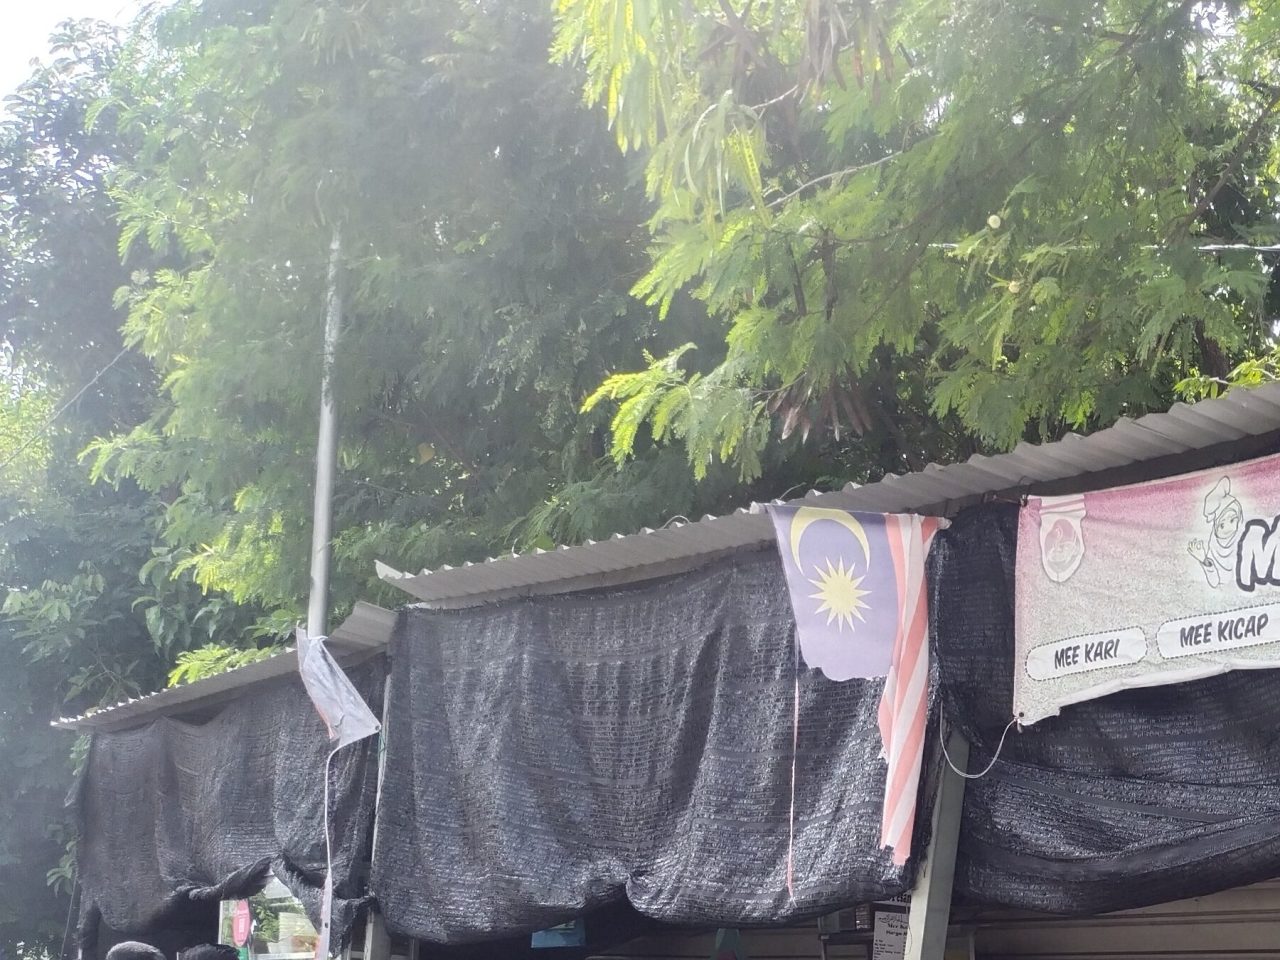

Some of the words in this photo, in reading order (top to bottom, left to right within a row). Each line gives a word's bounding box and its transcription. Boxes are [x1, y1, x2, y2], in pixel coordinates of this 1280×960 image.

[1180, 620, 1213, 647] MEE
[1217, 614, 1269, 641] KICAP
[1053, 643, 1081, 669] MEE
[1085, 638, 1119, 663] KARI
